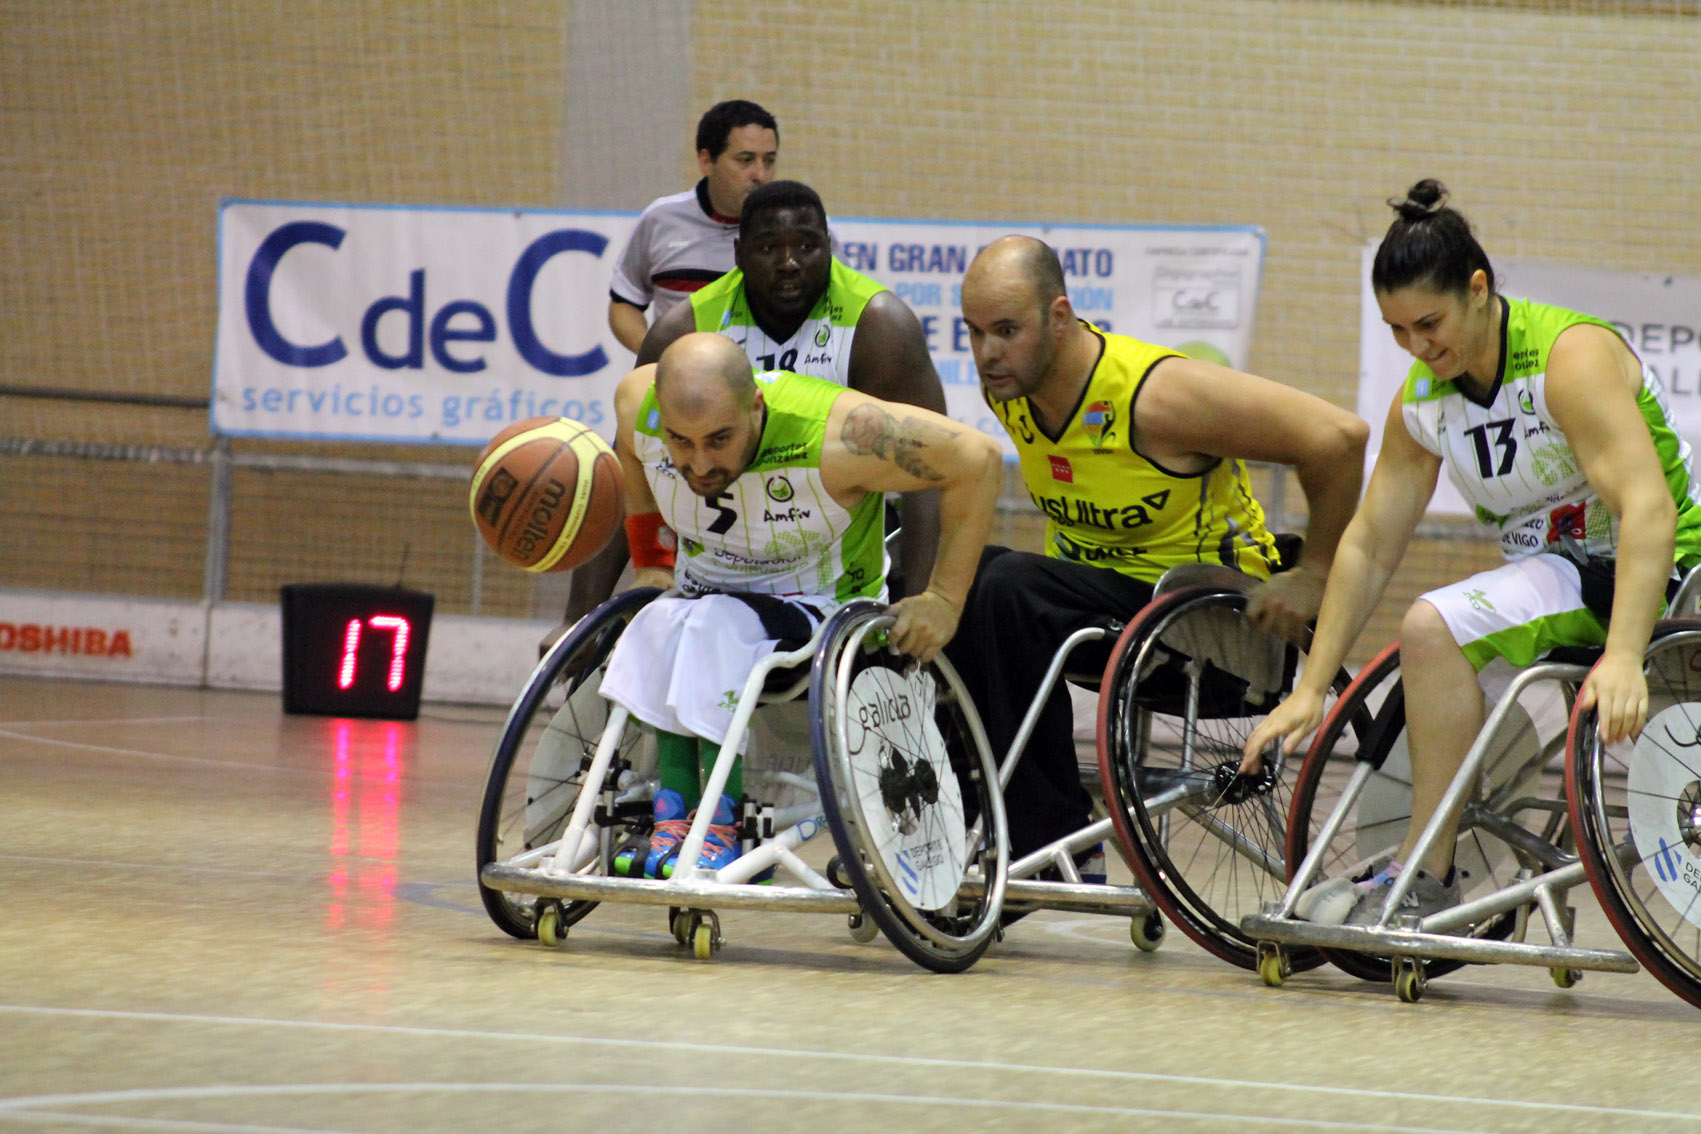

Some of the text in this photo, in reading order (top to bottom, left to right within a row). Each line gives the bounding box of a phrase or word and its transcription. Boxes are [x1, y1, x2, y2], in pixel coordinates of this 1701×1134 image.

[888, 243, 967, 273] GRAN
[241, 383, 605, 427] servicios gráficos
[1463, 417, 1518, 480] 13
[763, 508, 811, 522] Amfiv
[1511, 531, 1538, 548] VIGO
[337, 615, 411, 692] 17
